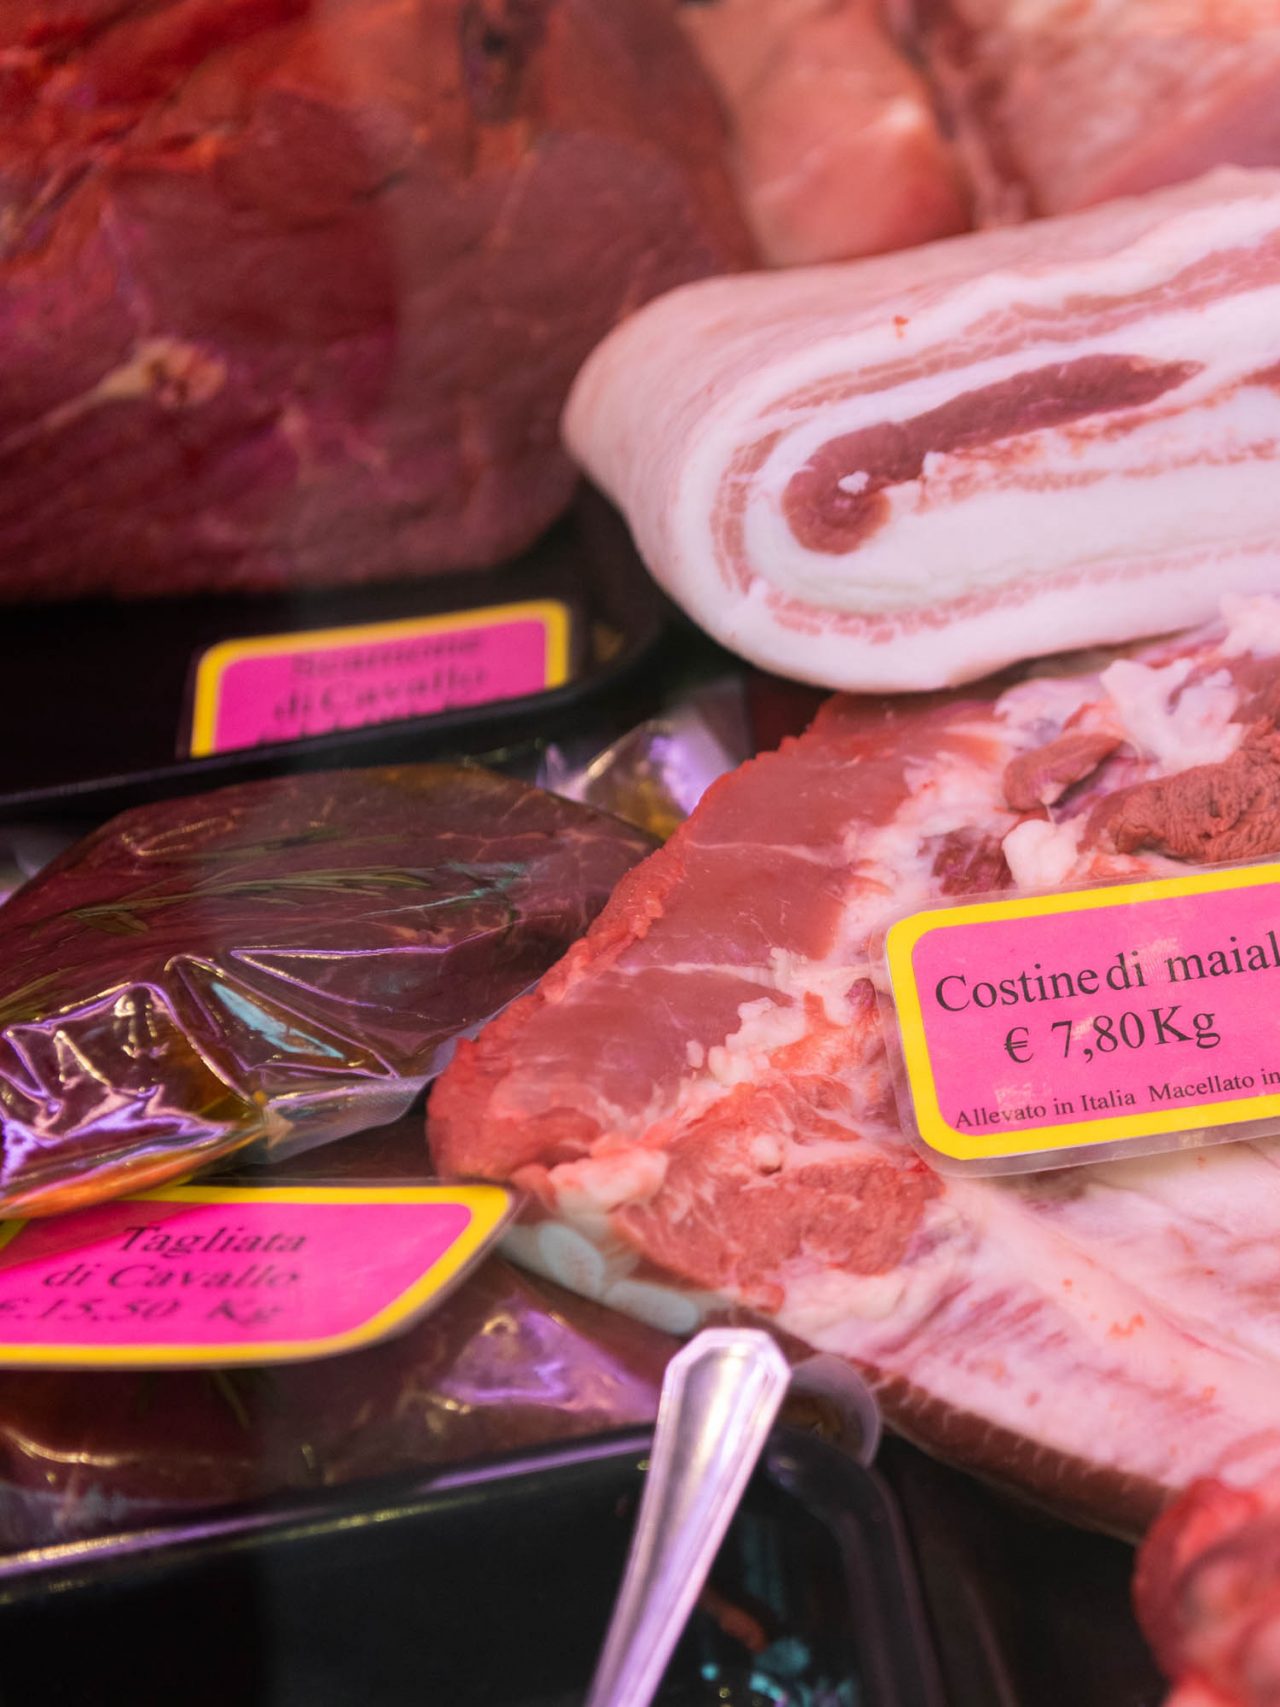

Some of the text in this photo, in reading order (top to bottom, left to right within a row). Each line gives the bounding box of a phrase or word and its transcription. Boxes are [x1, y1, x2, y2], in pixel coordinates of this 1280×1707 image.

[935, 961, 1099, 1012] Costine
[1105, 950, 1146, 991] di
[1003, 1006, 1222, 1064] € 7,80 Kg
[955, 1105, 1047, 1129] Allevato
[1053, 1100, 1075, 1116] in
[1081, 1090, 1136, 1111] Italia
[1148, 1074, 1255, 1102] Macellato
[116, 1225, 306, 1257] Tagliata
[42, 1262, 301, 1289] di Cavallo
